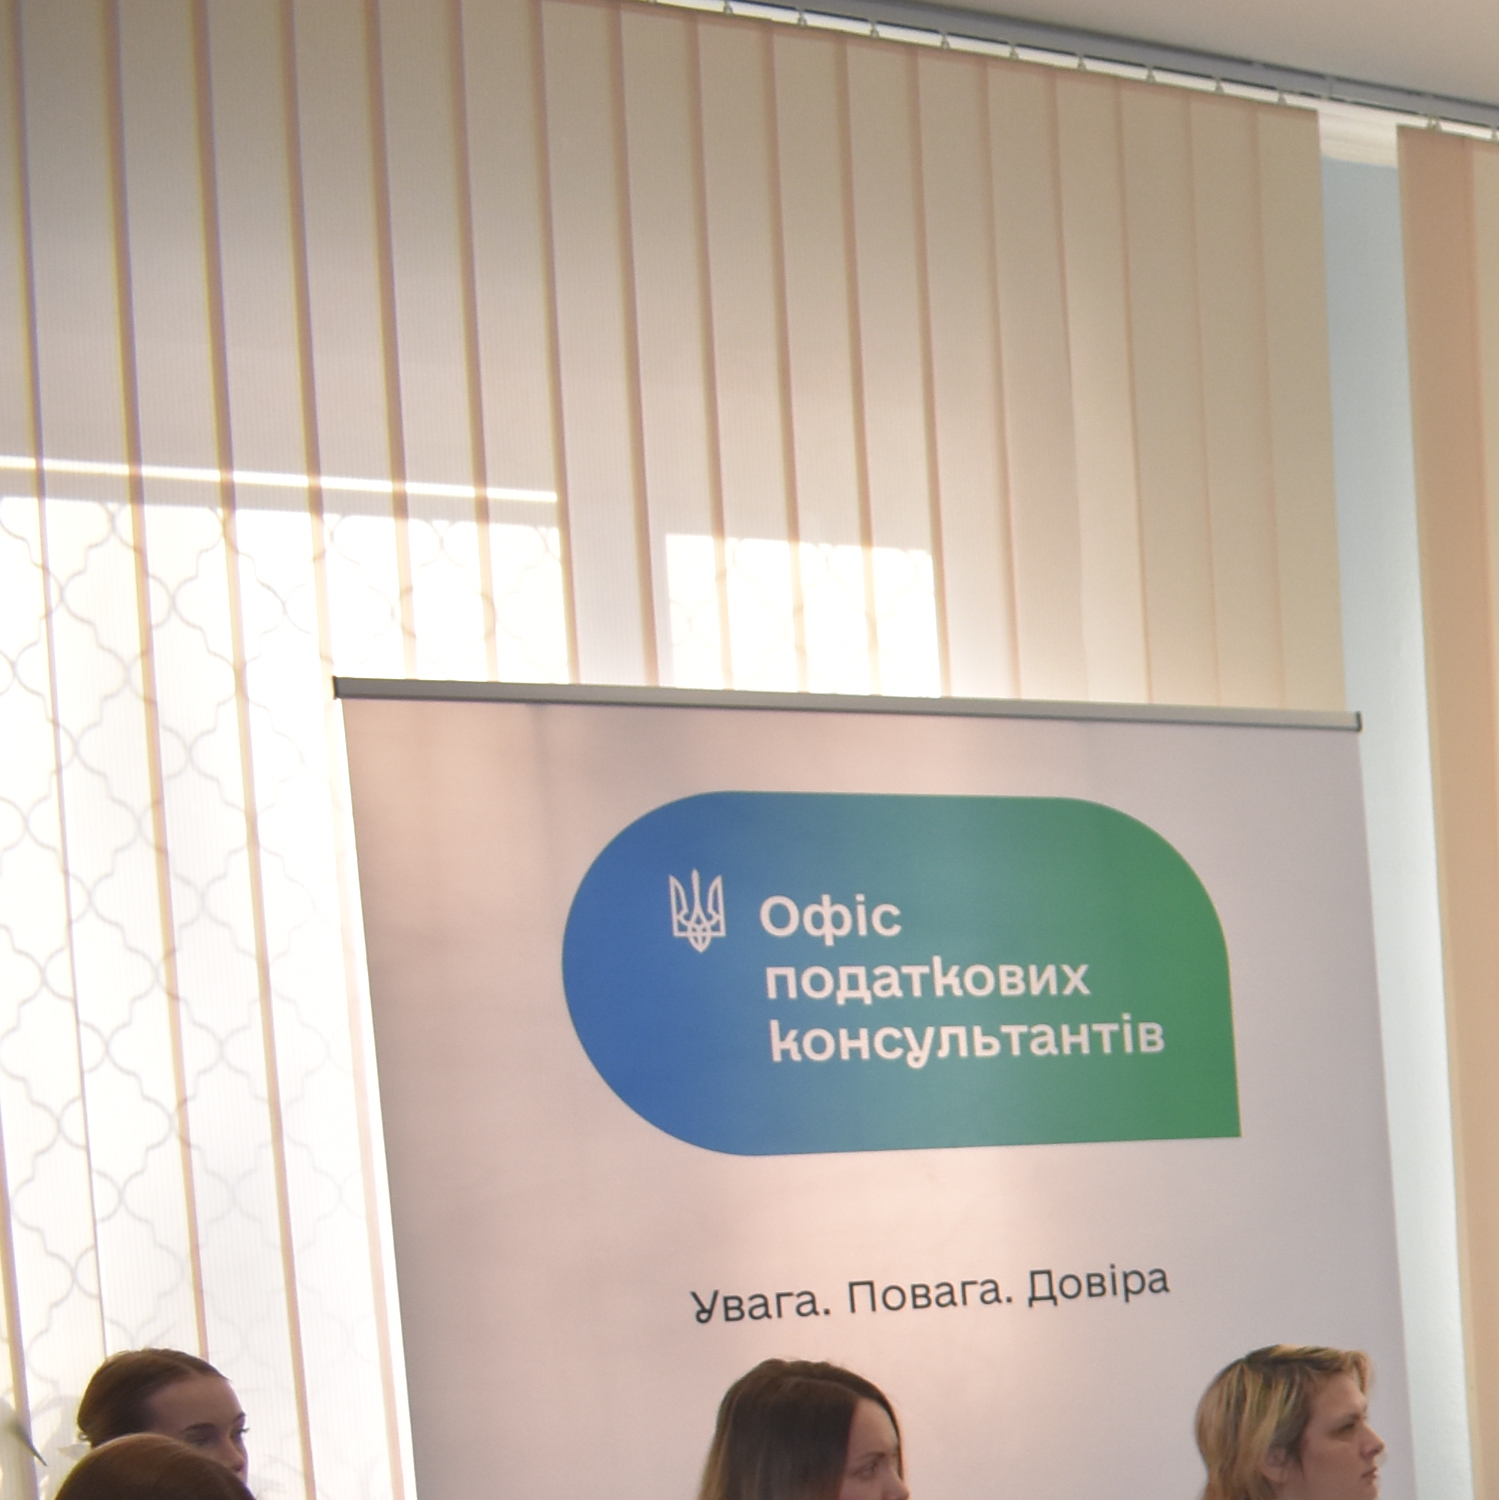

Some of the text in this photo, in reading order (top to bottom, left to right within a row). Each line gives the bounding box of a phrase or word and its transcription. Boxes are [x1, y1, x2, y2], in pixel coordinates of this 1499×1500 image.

[759, 893, 902, 946] Офіс
[765, 955, 1092, 1005] податкових
[769, 1013, 1166, 1069] консультантів
[690, 1264, 1171, 1325] Увага. Повага. Довіра
